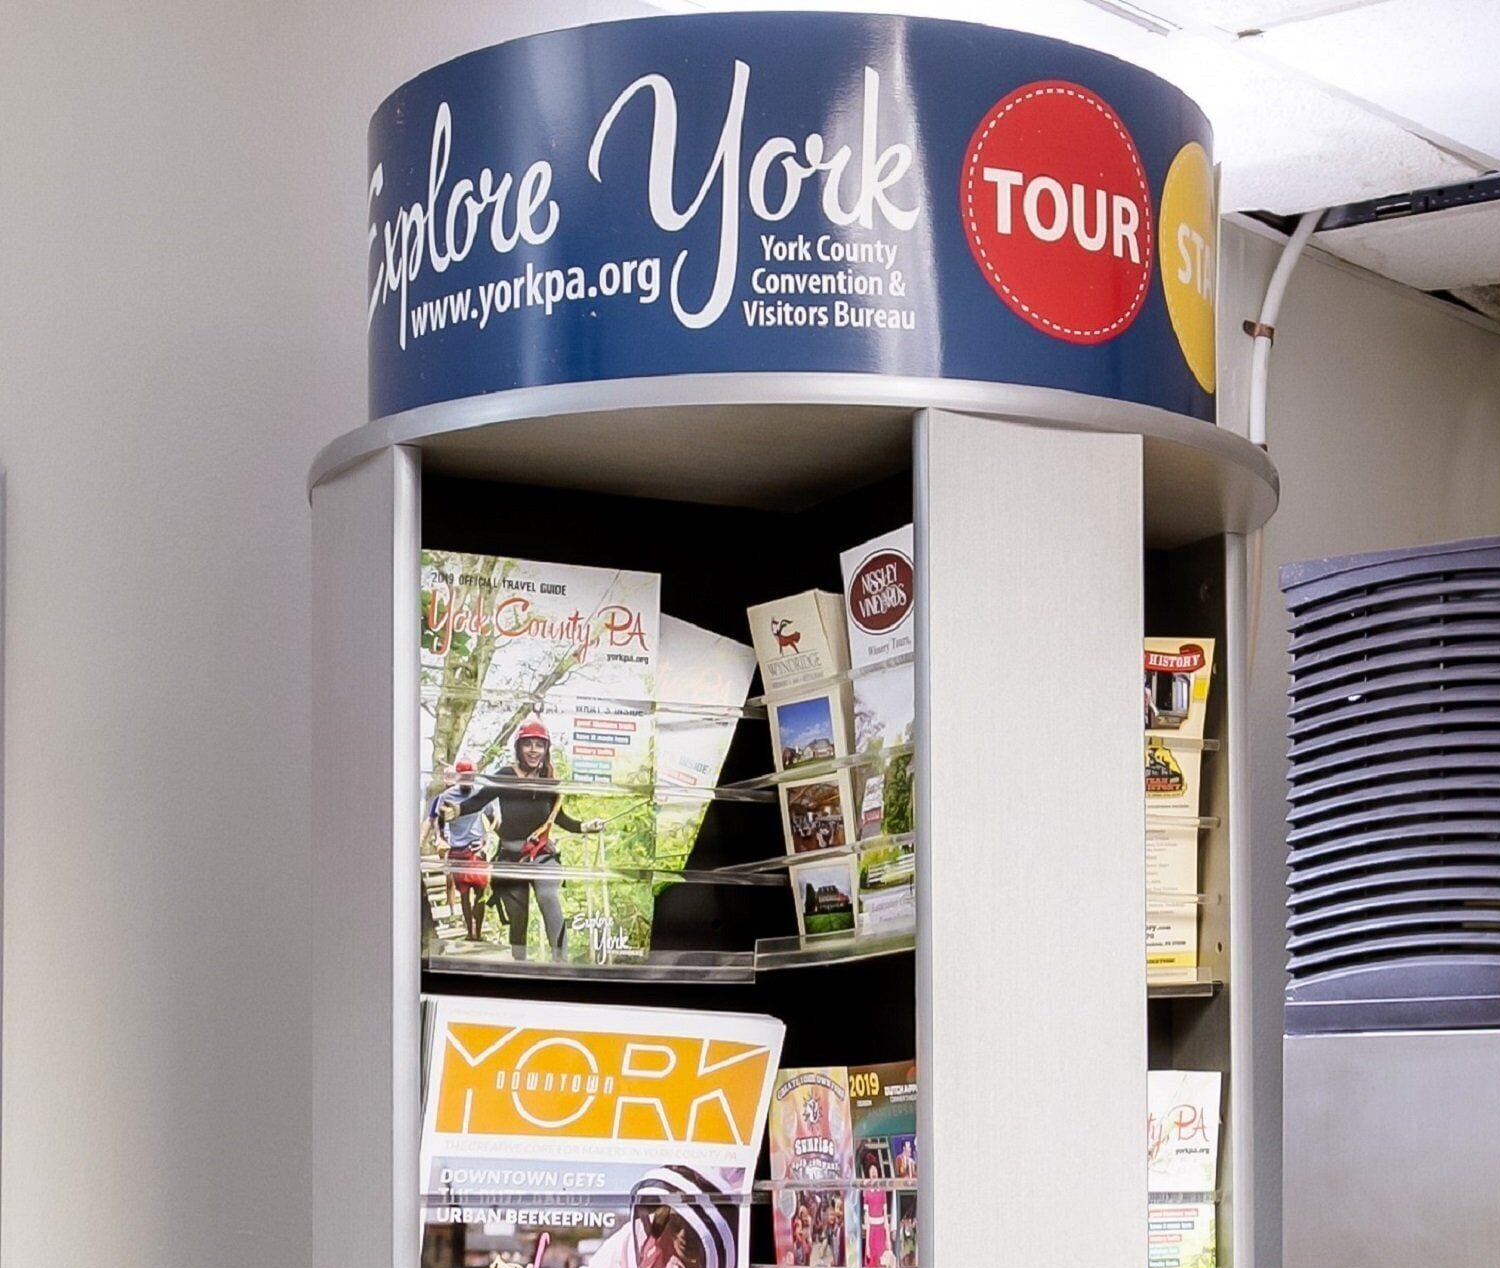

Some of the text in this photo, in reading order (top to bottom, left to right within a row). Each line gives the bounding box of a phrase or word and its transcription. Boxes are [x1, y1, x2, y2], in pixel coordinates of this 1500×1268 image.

[588, 59, 920, 329] York
[983, 167, 1140, 264] TOUR
[760, 235, 898, 269] York County
[410, 257, 661, 339] www.yorkpa.org
[751, 268, 907, 297] Convention &
[743, 300, 916, 331] Visitors Bureau
[459, 575, 498, 589] OFFICIAL
[502, 579, 536, 592] TRAVEL
[540, 583, 567, 596] GUIDE
[862, 562, 897, 595] NISSLEY
[859, 583, 907, 618] VINEYARDS
[496, 597, 600, 665] County,
[598, 605, 649, 651] PA
[1149, 653, 1200, 667] HISTORY
[445, 1024, 771, 1146] YORK
[496, 1070, 614, 1096] DOWNTOWN
[849, 1072, 879, 1097] 2019
[1168, 1104, 1210, 1142] PA
[440, 1167, 606, 1188] DOWNTOWN GETS
[436, 1207, 616, 1229] URBAN BEEKEEPING
